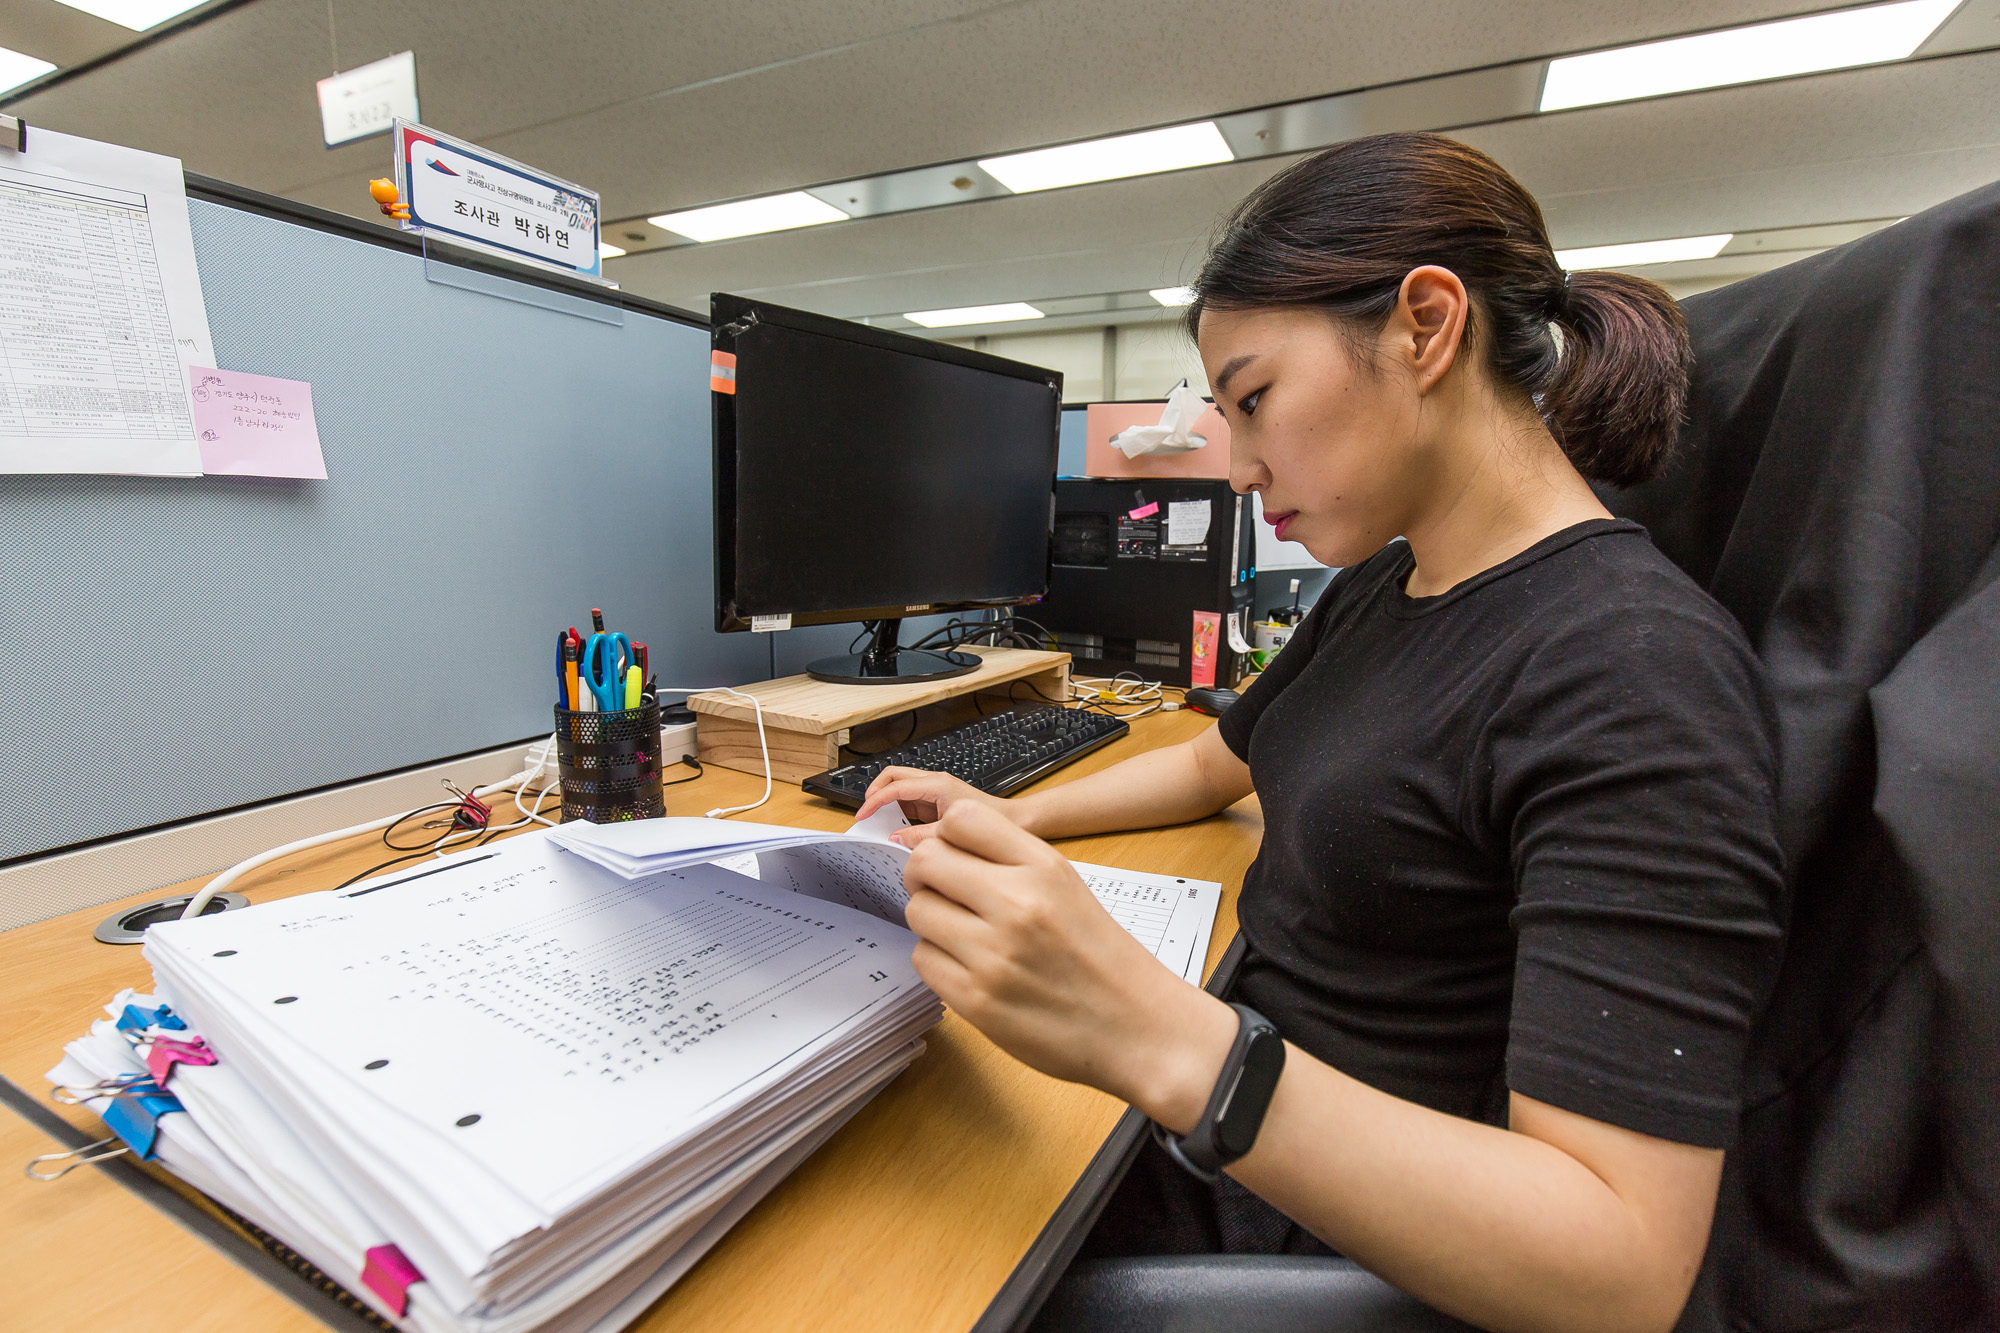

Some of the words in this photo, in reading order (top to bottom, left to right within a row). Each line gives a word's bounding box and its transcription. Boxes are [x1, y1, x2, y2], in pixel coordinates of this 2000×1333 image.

[467, 175, 496, 193] 군사망사고
[497, 186, 534, 206] 진상규명위원회
[453, 199, 501, 228] 조사관
[514, 216, 570, 250] 박하연
[213, 391, 234, 399] 경기도
[232, 404, 268, 416] 222-20
[905, 603, 930, 612] SAMSUNG
